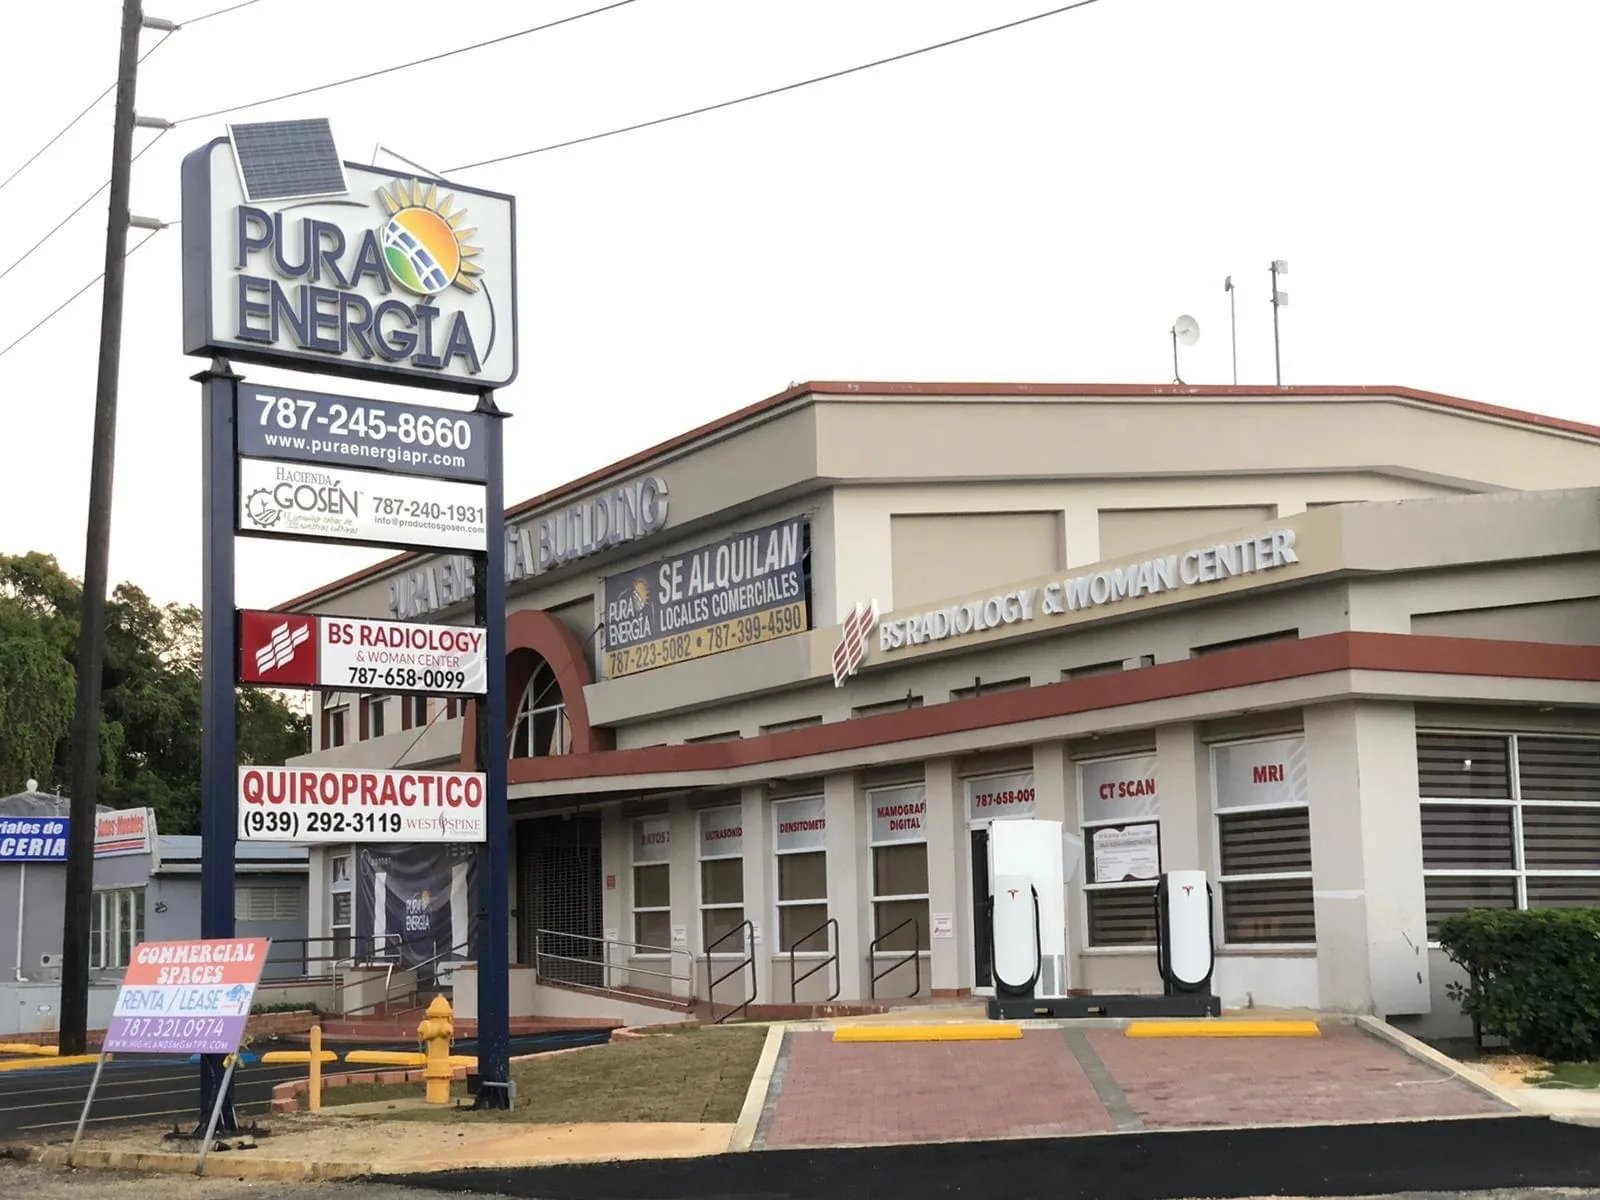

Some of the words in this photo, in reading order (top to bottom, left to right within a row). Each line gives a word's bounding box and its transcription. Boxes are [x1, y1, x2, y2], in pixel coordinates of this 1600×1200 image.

[234, 205, 392, 294] PURA
[235, 275, 481, 375] ENERGÍA
[255, 394, 472, 450] 787-245-8660
[265, 434, 466, 468] www.puraenergiapr.com
[273, 480, 359, 518] GOSÉN
[373, 496, 484, 524] 787-240-1931
[374, 516, 485, 534] info@productosgosen.com
[538, 475, 669, 569] BUILDING
[658, 559, 684, 605] SE
[688, 523, 798, 597] ALQUILAN
[905, 587, 1039, 645] RADIOLOGY
[1041, 582, 1065, 616] &
[1064, 555, 1178, 610] WOMAN
[1179, 527, 1299, 586] CENTER
[609, 597, 635, 623] PURA
[660, 597, 709, 632] LOCALES
[712, 571, 799, 617] COMERCIALES
[328, 622, 354, 645] BS
[360, 625, 482, 653] RADIOLOGY
[610, 634, 691, 675] 787-223-5082
[707, 604, 801, 652] 787-399-4590
[357, 650, 365, 662] &
[368, 651, 415, 665] WOMAN
[418, 654, 460, 668] CENTER
[349, 667, 465, 689] 787-658-0099
[1253, 764, 1284, 784] MRI
[243, 770, 482, 808] QUIROPRACTICO
[1099, 783, 1116, 800] CT
[1118, 778, 1155, 798] SCAN
[43, 821, 63, 834] de
[244, 811, 299, 837] (939)
[306, 812, 402, 833] 292-3119
[406, 818, 438, 829] WEST
[448, 818, 481, 830] SPINE
[890, 818, 921, 831] DIGITAL
[137, 943, 256, 964] COMMERCIAL
[157, 965, 224, 985] SPACES
[121, 989, 163, 1011] RENTA
[121, 1018, 225, 1037] 787.321.0974
